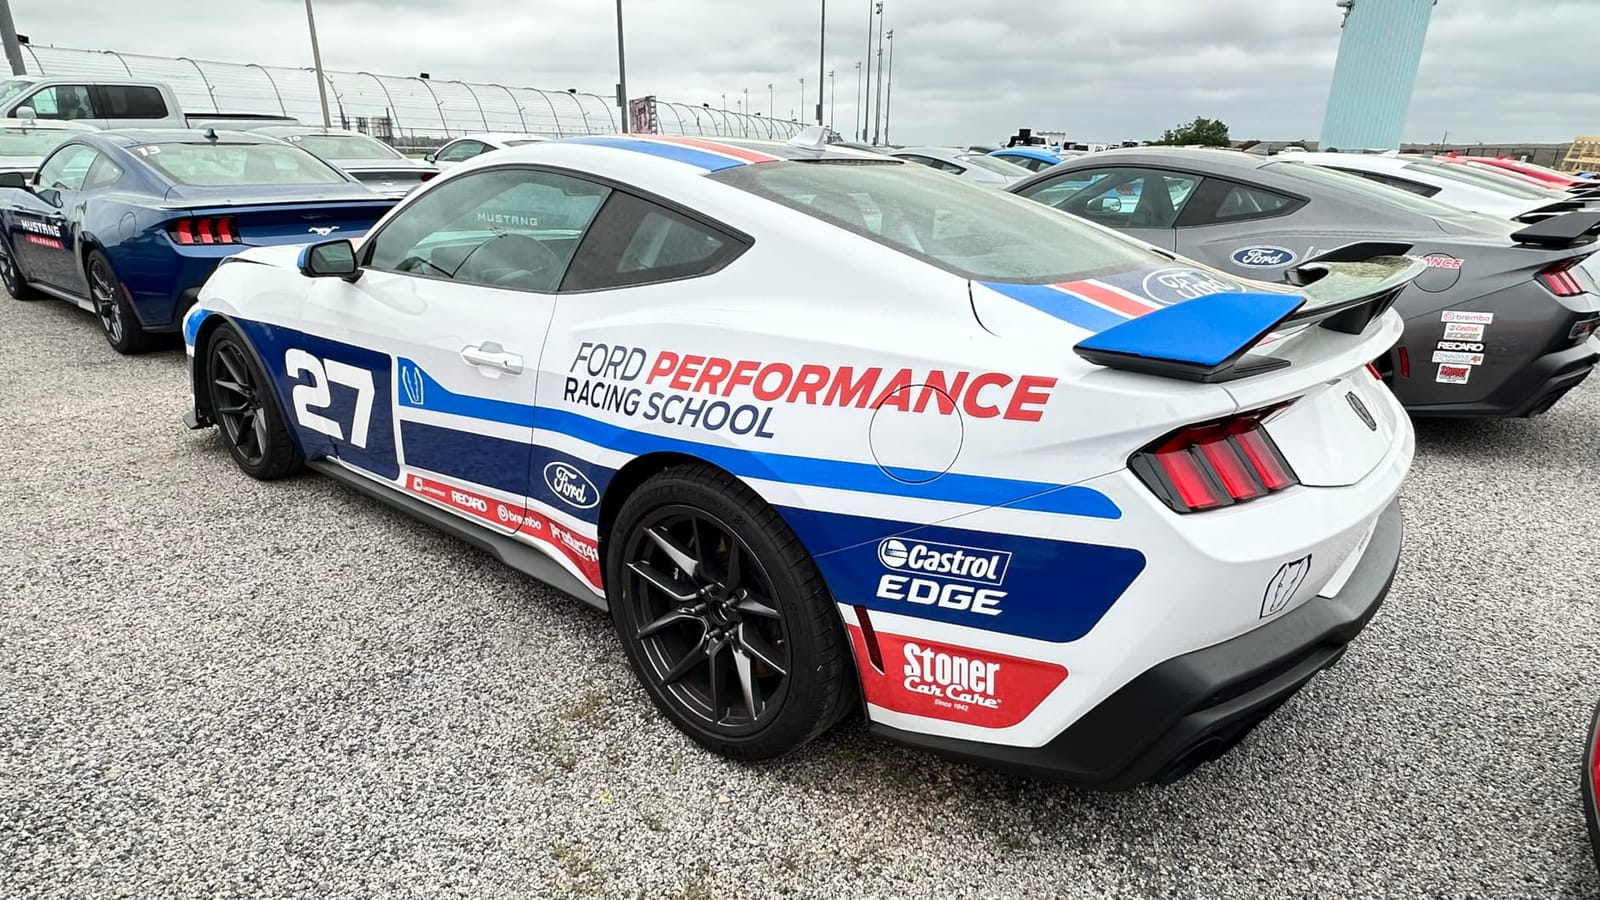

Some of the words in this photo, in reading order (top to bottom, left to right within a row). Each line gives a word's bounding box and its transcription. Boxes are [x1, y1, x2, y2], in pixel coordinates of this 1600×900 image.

[137, 145, 162, 157] 13
[21, 219, 61, 237] MUSTANG
[477, 212, 538, 226] MUSTANG
[1242, 247, 1283, 265] Ford
[1456, 314, 1490, 322] brembo
[1437, 341, 1484, 351] RECARO
[569, 342, 646, 382] FORD
[645, 351, 1058, 422] PERFORMANCE
[285, 348, 375, 448] 27
[563, 377, 641, 417] RACING
[643, 392, 775, 439] SCHOOL
[553, 466, 587, 504] Ford
[451, 490, 487, 512] RECARO
[508, 510, 542, 530] brembo
[908, 544, 1000, 580] Castrol
[876, 574, 1008, 616] EDGE
[903, 642, 1000, 695] Stoner
[903, 675, 944, 697] Car
[945, 684, 999, 709] Care
[934, 698, 952, 709] Since
